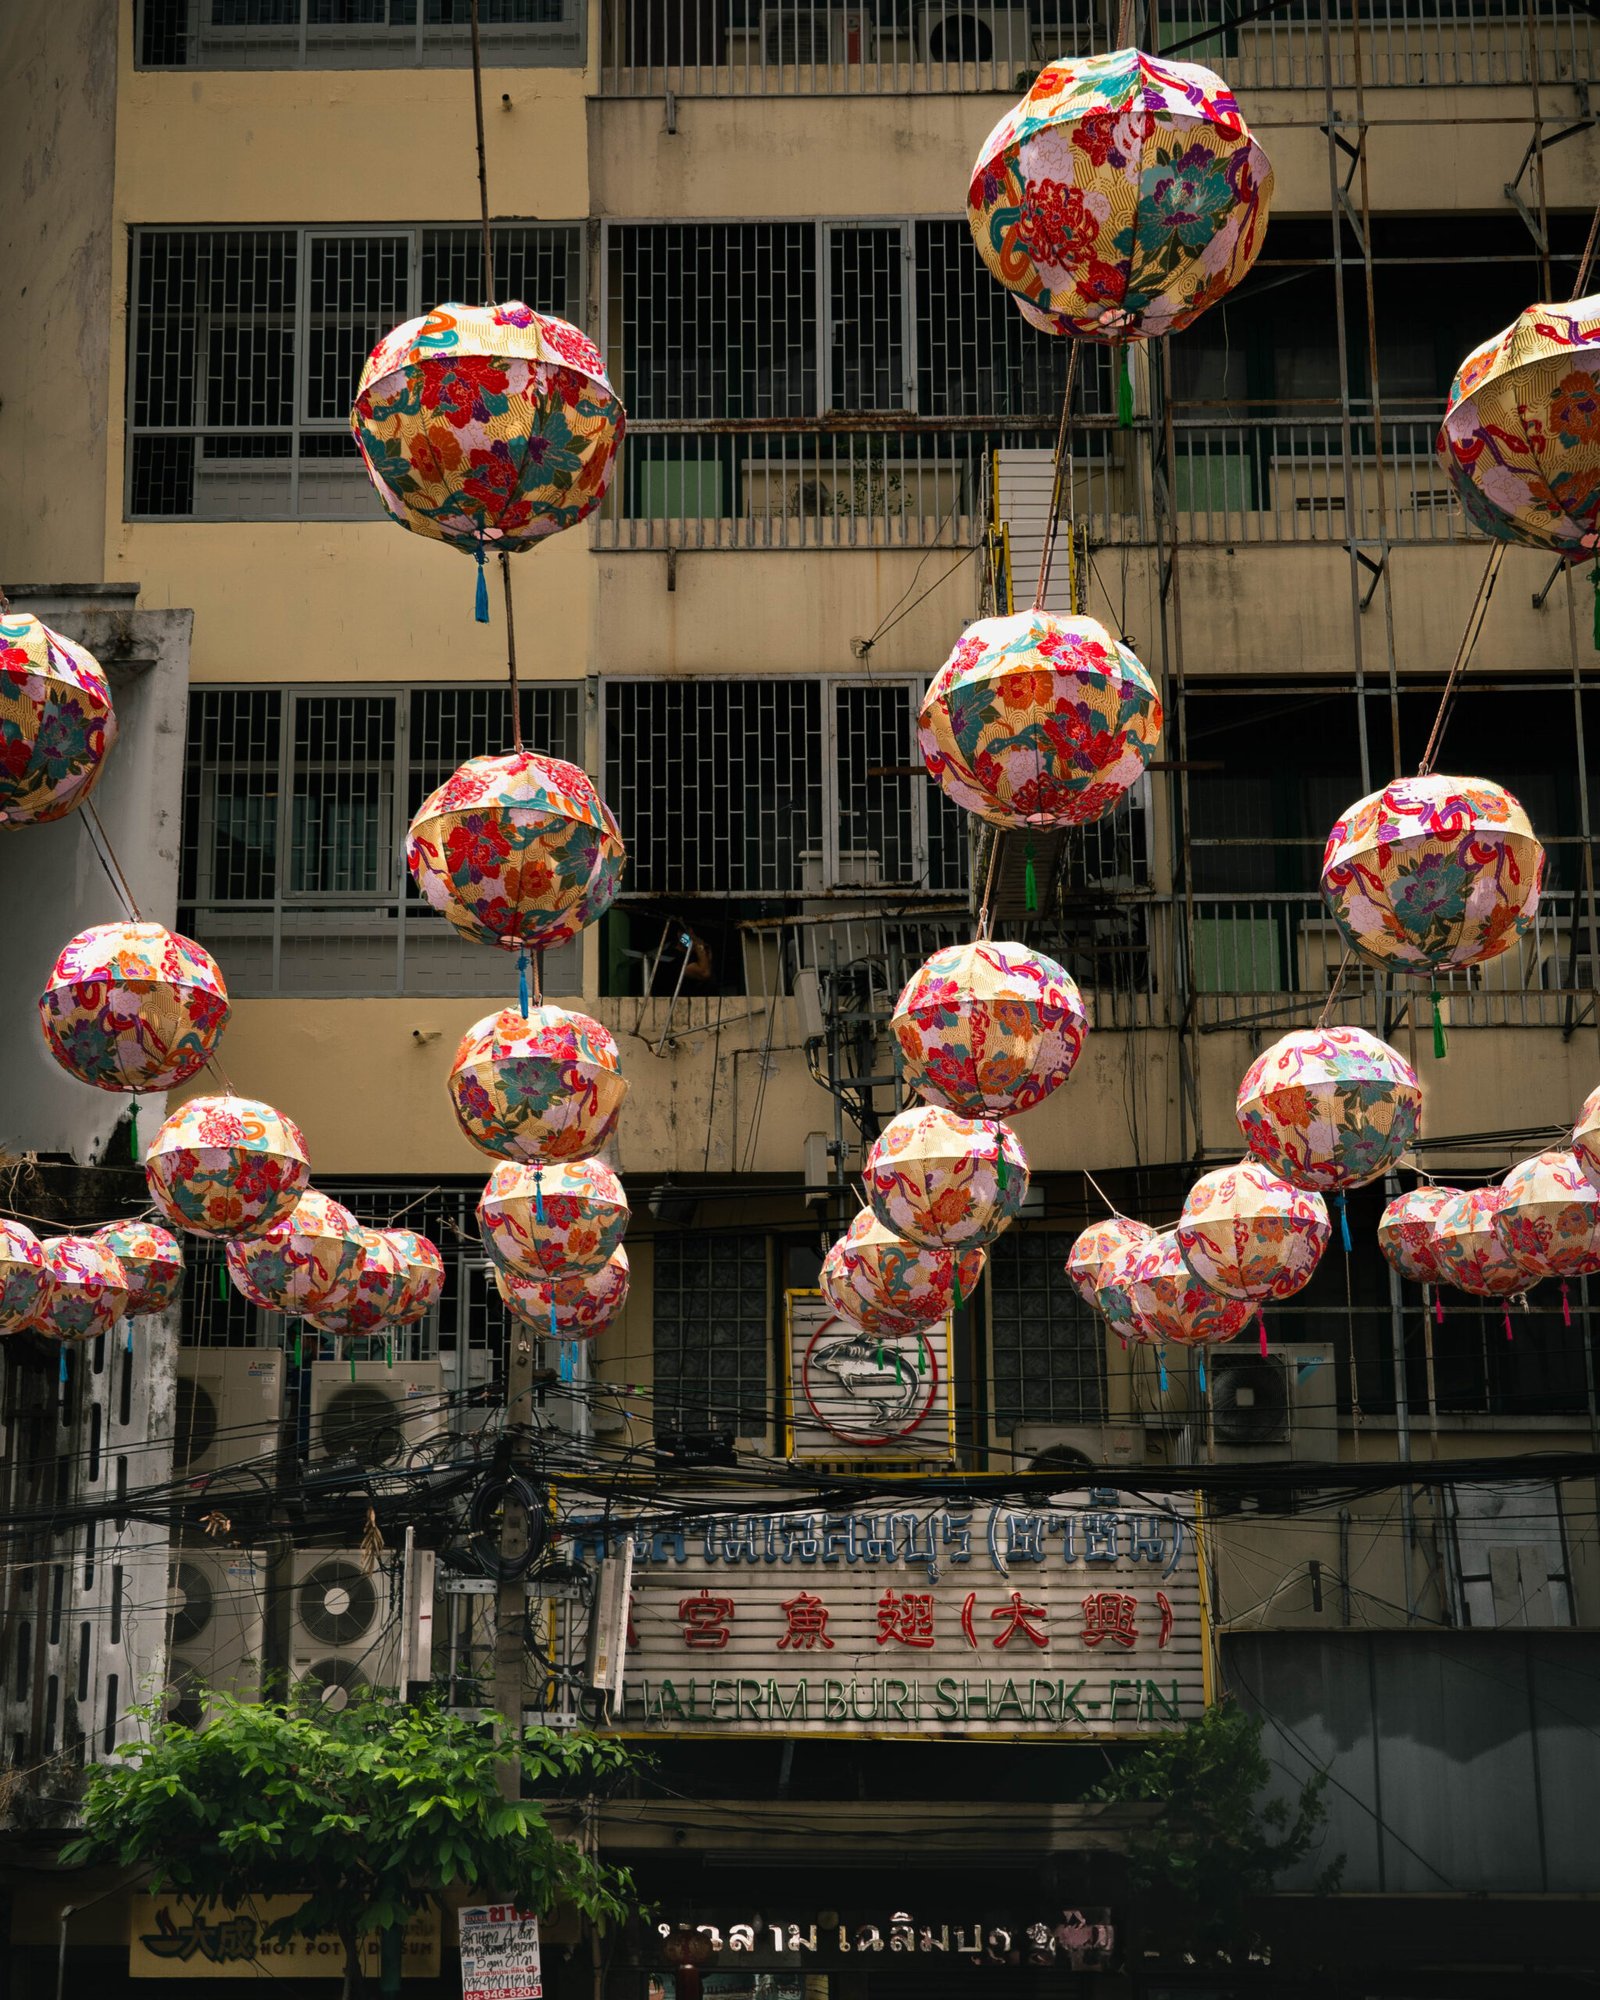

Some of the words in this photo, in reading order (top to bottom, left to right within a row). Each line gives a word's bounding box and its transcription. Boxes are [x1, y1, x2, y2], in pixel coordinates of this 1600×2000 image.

[824, 1677, 919, 1722] BURI
[934, 1677, 1179, 1722] SHARK-FIN
[260, 1942, 296, 1955] HOT
[305, 1942, 341, 1955] POT
[466, 1987, 539, 2000] 02-946-6206
